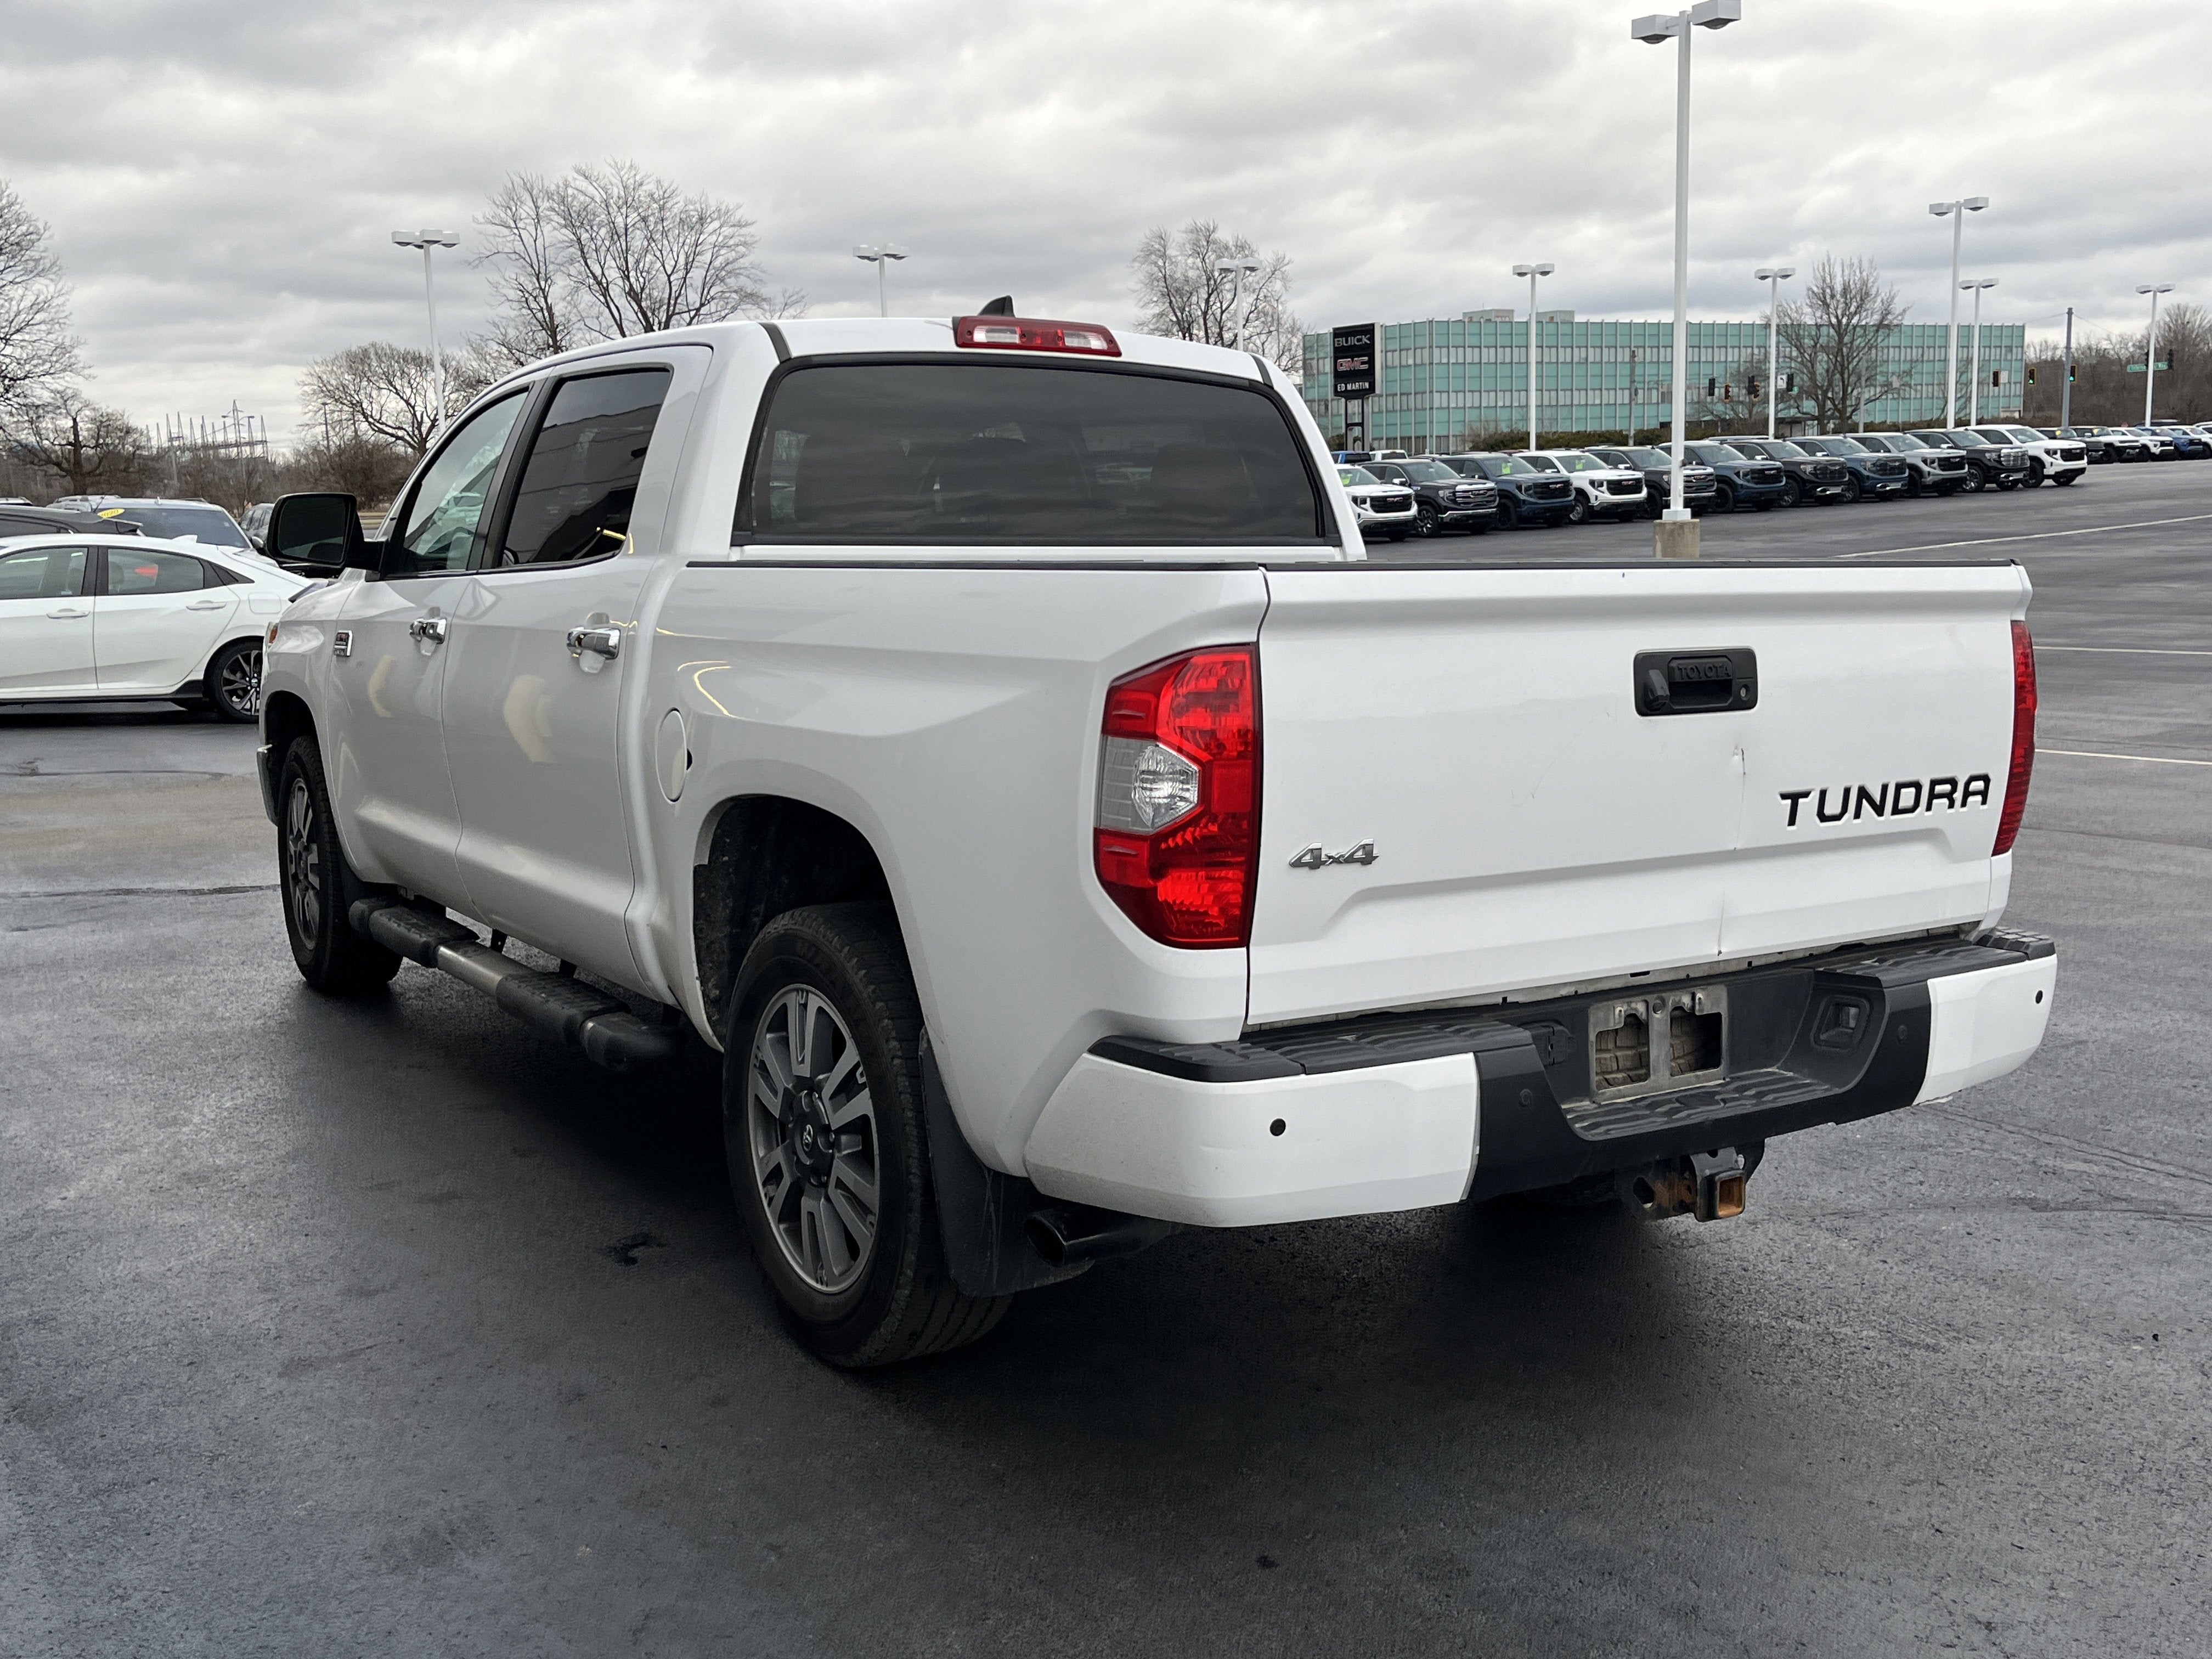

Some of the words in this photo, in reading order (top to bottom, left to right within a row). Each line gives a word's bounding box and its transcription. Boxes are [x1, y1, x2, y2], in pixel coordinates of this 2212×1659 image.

[1335, 335, 1370, 347] BUICK
[1337, 357, 1368, 371] GMC
[1677, 664, 1731, 680] TOYOTA
[1779, 772, 1991, 828] TUNDRA
